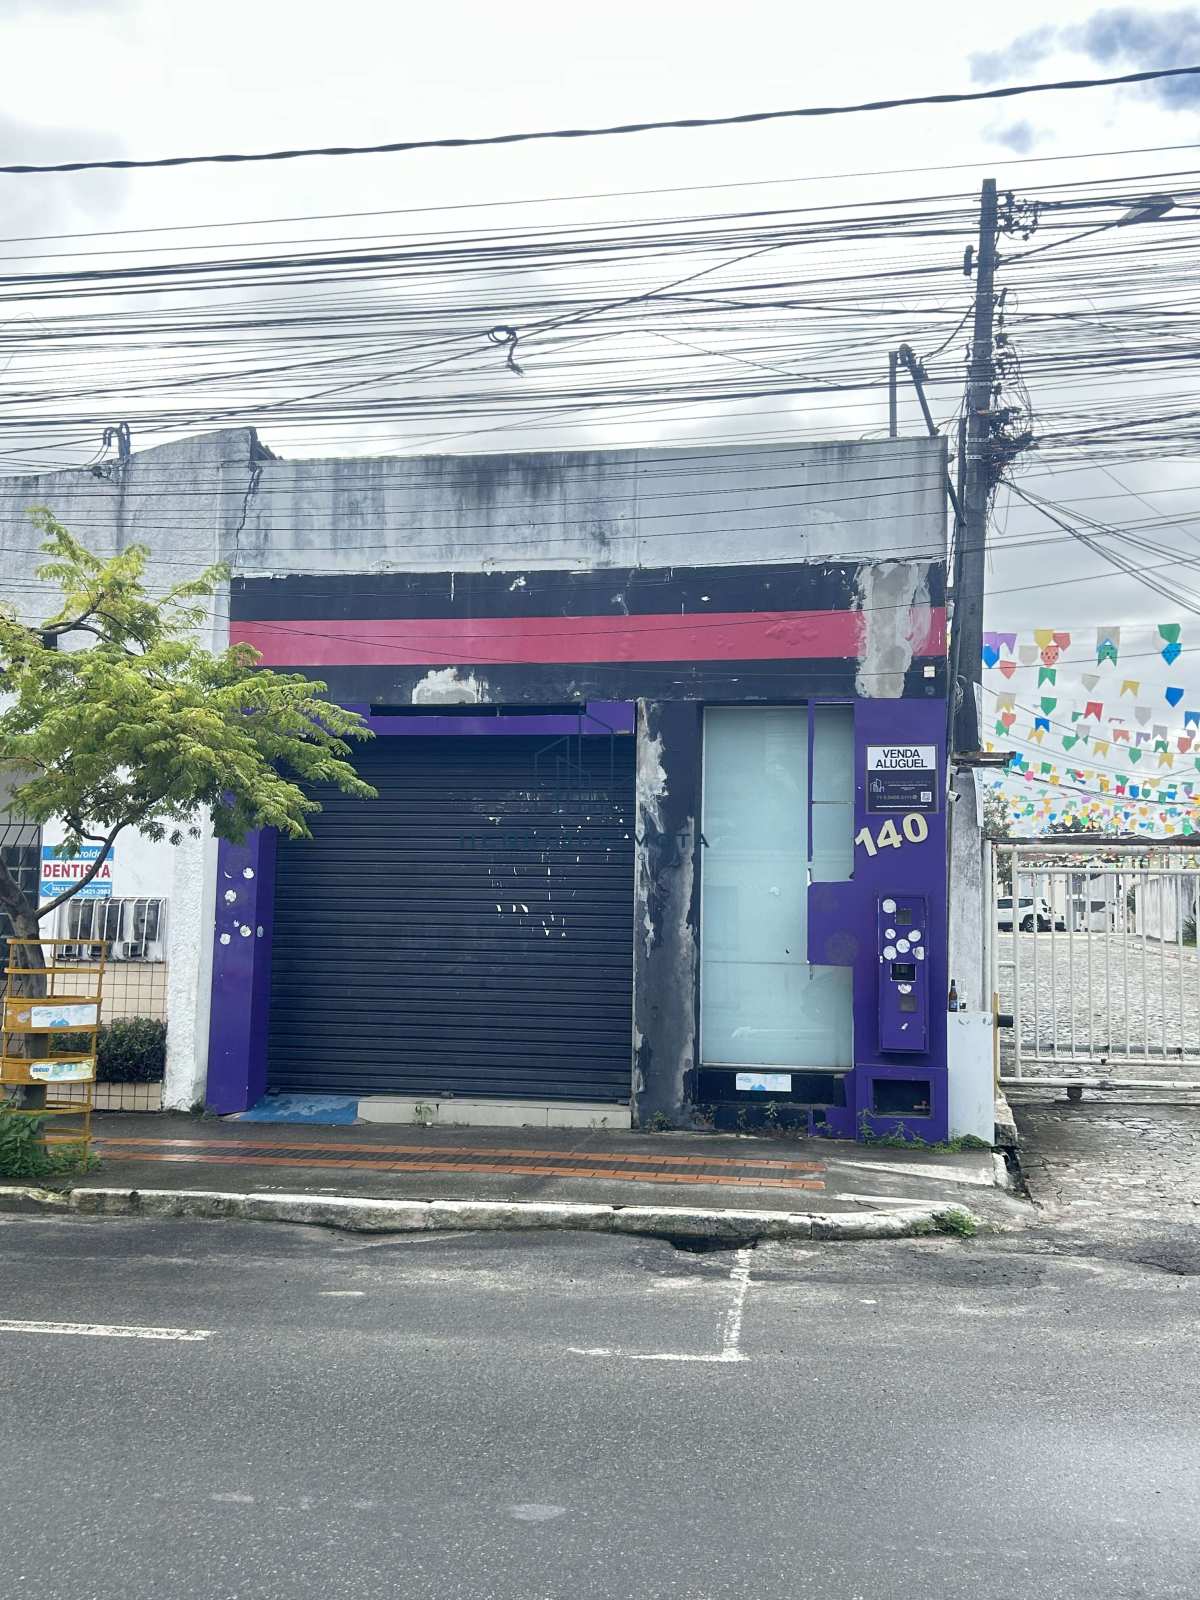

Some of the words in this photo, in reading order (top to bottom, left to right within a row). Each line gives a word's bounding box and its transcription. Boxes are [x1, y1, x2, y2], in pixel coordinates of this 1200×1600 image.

[883, 749, 920, 758] VENDA
[876, 759, 927, 768] ALUGUEL
[855, 813, 928, 857] 140
[43, 864, 110, 878] DENTISA
